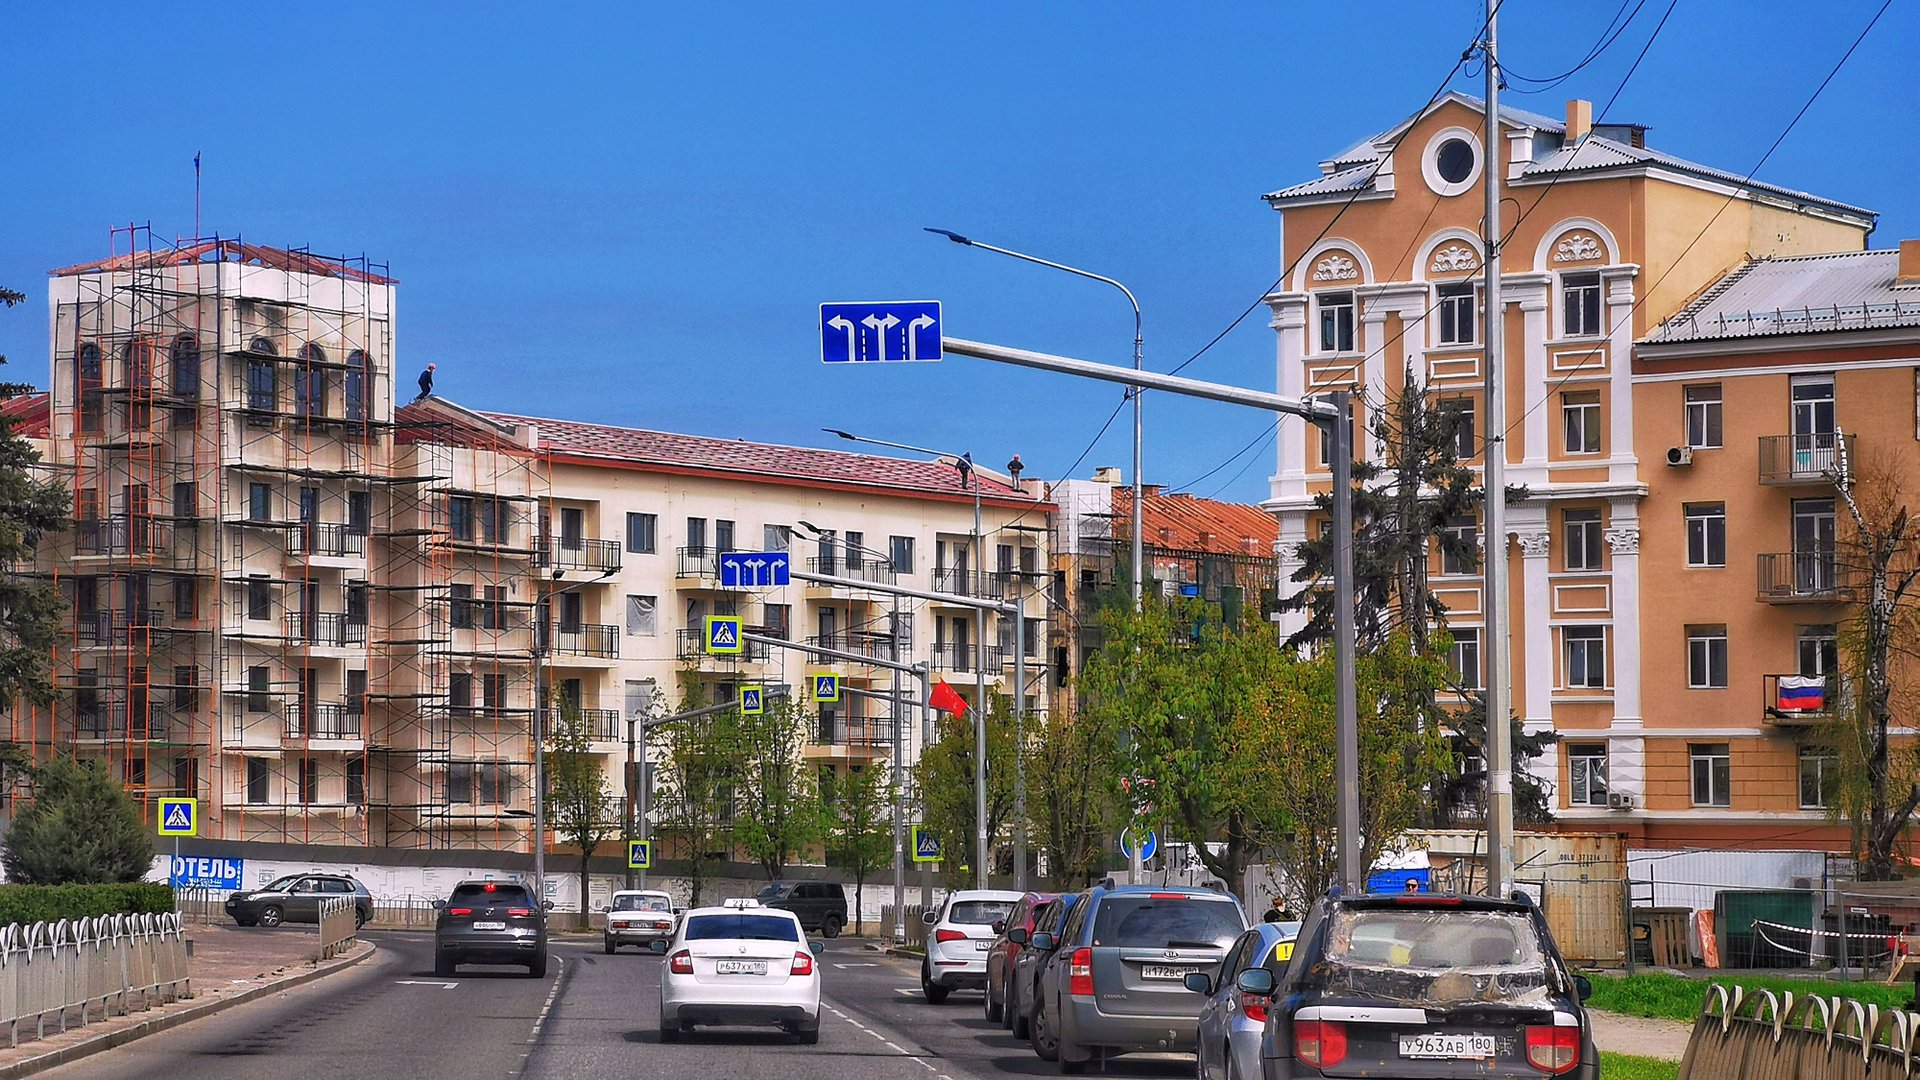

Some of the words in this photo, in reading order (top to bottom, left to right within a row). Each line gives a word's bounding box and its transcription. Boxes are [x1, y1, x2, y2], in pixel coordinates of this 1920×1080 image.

[172, 857, 236, 879] ОТЕЛЬ
[733, 899, 750, 907] 222
[720, 960, 752, 970] Р637ХХ
[753, 962, 766, 970] 180
[1145, 967, 1182, 977] Н172ВС
[1405, 1038, 1464, 1053] У963АВ
[1468, 1038, 1491, 1050] 180
